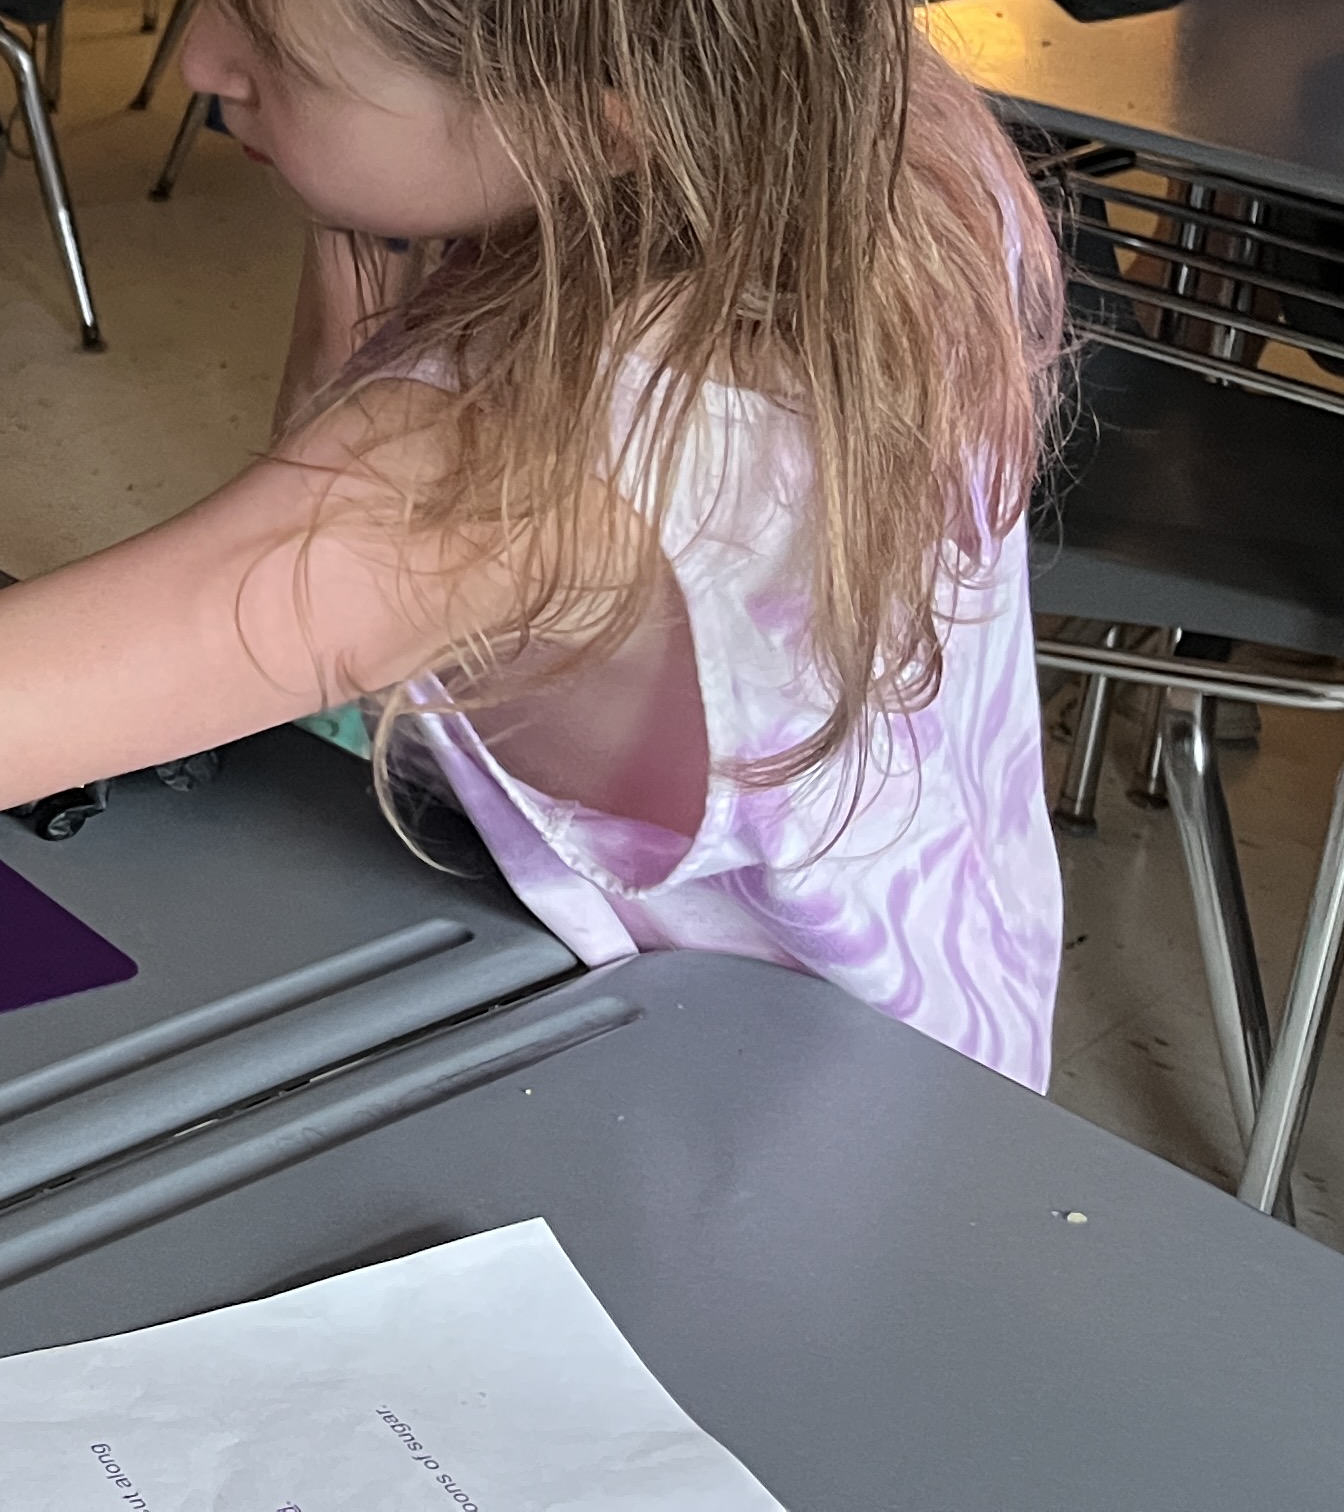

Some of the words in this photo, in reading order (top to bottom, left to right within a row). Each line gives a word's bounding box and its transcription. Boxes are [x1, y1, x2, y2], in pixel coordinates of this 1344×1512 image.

[375, 1404, 423, 1451] sugar.
[91, 1443, 132, 1488] along
[411, 1455, 440, 1470] of
[122, 1492, 149, 1512] ut
[436, 1474, 479, 1512] oons
